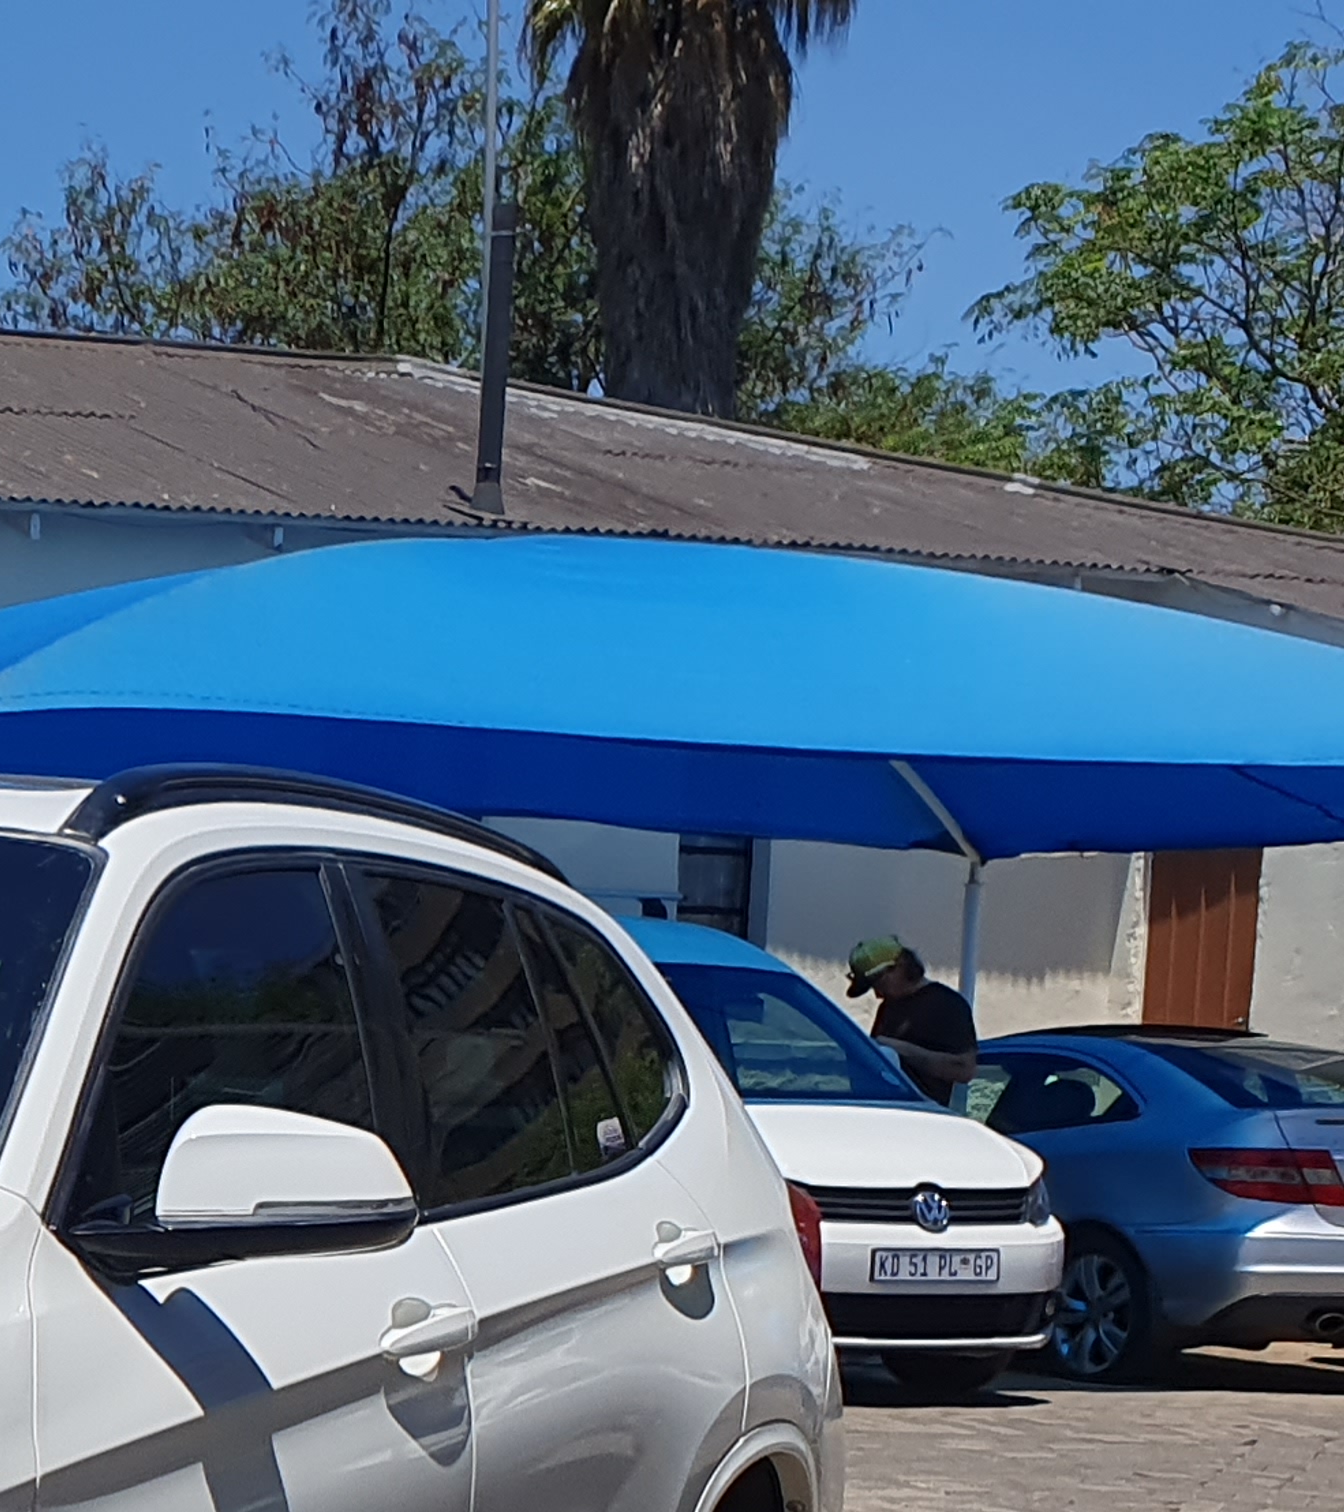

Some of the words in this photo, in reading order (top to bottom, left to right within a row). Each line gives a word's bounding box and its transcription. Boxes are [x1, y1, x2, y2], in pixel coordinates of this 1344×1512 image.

[878, 1253, 900, 1277] KD
[908, 1253, 928, 1277] 51
[938, 1253, 958, 1277] PL
[973, 1253, 994, 1277] GP
